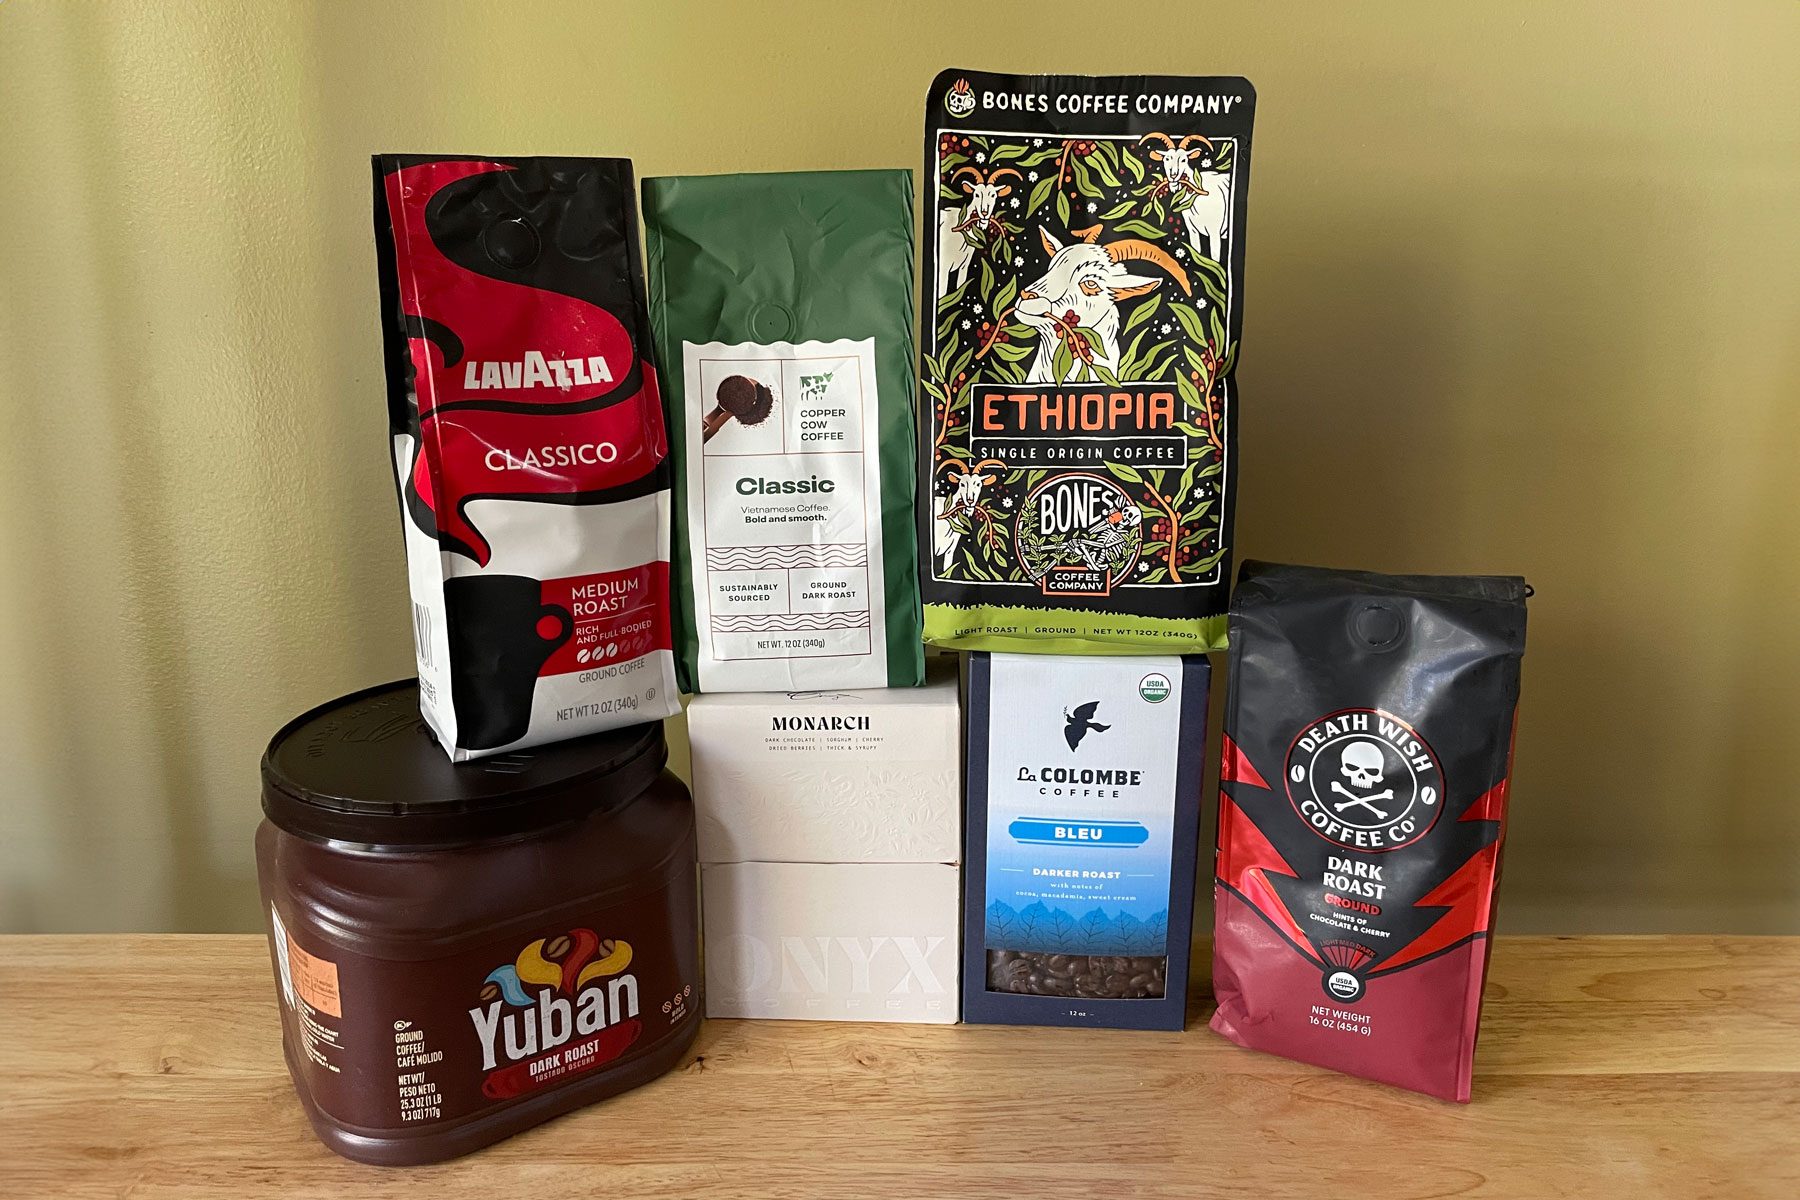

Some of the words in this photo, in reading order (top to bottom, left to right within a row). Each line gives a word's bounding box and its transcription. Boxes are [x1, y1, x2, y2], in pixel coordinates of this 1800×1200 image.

[982, 92, 1048, 113] BONES
[1055, 94, 1128, 114] COFFEE
[464, 350, 613, 390] LAVAZZA
[800, 408, 846, 418] COPPER
[983, 392, 1175, 431] ETHIOPIA
[800, 420, 828, 430] COW
[800, 431, 844, 441] COFFEE
[485, 442, 618, 472] CLASSICO
[981, 447, 1037, 459] SINGLE
[1047, 446, 1103, 459] ORIGIN
[1113, 447, 1175, 459] COFFEE
[735, 475, 836, 496] Classic
[741, 505, 796, 514] Vietnamese
[796, 504, 831, 513] Coffee.
[1040, 482, 1114, 535] BONES
[745, 514, 767, 524] Bold
[768, 514, 787, 523] and
[788, 513, 828, 523] smooth.
[1054, 572, 1100, 582] COFFEE
[572, 578, 639, 600] MEDIUM
[719, 583, 779, 592] SUSTAINABLY
[810, 581, 847, 589] GROUND
[1048, 581, 1104, 591] COMPANY
[728, 594, 770, 602] SOURCED
[802, 592, 826, 600] DARK
[828, 591, 856, 599] ROAST
[573, 595, 628, 617] ROAST
[575, 625, 599, 636] RICH
[955, 627, 983, 636] LIGHT
[1115, 628, 1132, 636] WT
[1162, 630, 1198, 640] (340G)
[576, 634, 598, 645] AND
[757, 641, 771, 649] NET
[771, 640, 784, 649] WT.
[785, 640, 795, 648] 12
[795, 640, 802, 648] OZ
[802, 638, 825, 649] (340g)
[579, 667, 617, 683] GROUND
[618, 658, 645, 675] COFFEE
[1146, 680, 1164, 688] USDA
[556, 708, 574, 721] NET
[575, 705, 589, 718] WT
[591, 702, 599, 715] 12
[601, 700, 613, 714] OZ
[613, 694, 639, 714] (340g)
[772, 716, 870, 731] MONARCH
[1297, 714, 1368, 753] DEATH
[1377, 716, 1434, 773] WISH
[1017, 766, 1037, 782] La
[1040, 767, 1142, 786] COLOMBE
[1039, 787, 1119, 798] COFFEE
[1300, 800, 1384, 847] COFFEE
[1054, 826, 1103, 840] BLEU
[1033, 868, 1079, 878] DARKER
[1082, 870, 1122, 879] ROAST
[1328, 856, 1383, 881] DARK
[1323, 871, 1387, 900] ROAST
[1324, 893, 1381, 916] GROUND
[1309, 913, 1352, 930] CHOCOLATE
[1360, 926, 1391, 938] CHERRY
[1333, 911, 1355, 923] HINTS
[1356, 918, 1368, 926] OF
[710, 934, 948, 994] ONYX
[1335, 977, 1353, 986] USDA
[1312, 1005, 1330, 1016] NET
[1333, 1009, 1371, 1024] WEIGHT
[469, 974, 640, 1071] Yuban
[1309, 1016, 1320, 1025] 16
[1322, 1019, 1335, 1029] OZ
[1336, 1021, 1358, 1033] (454
[1360, 1026, 1371, 1036] G)
[395, 1030, 423, 1043] GROUND
[397, 1053, 416, 1067] CAFÉ
[416, 1051, 443, 1065] MOLIDO
[529, 1053, 560, 1076] DARK
[564, 1039, 600, 1063] ROAST
[535, 1067, 566, 1083] TOSTADO
[568, 1055, 595, 1071] OSCURO
[398, 1074, 411, 1086] NET
[399, 1086, 417, 1098] PESO
[418, 1083, 436, 1095] NETO
[400, 1097, 415, 1110] 25.3
[416, 1097, 425, 1108] OZ
[433, 1093, 442, 1105] LB
[401, 1109, 412, 1121] 9.3
[412, 1107, 424, 1120] OZ)
[425, 1106, 441, 1118] 717g
